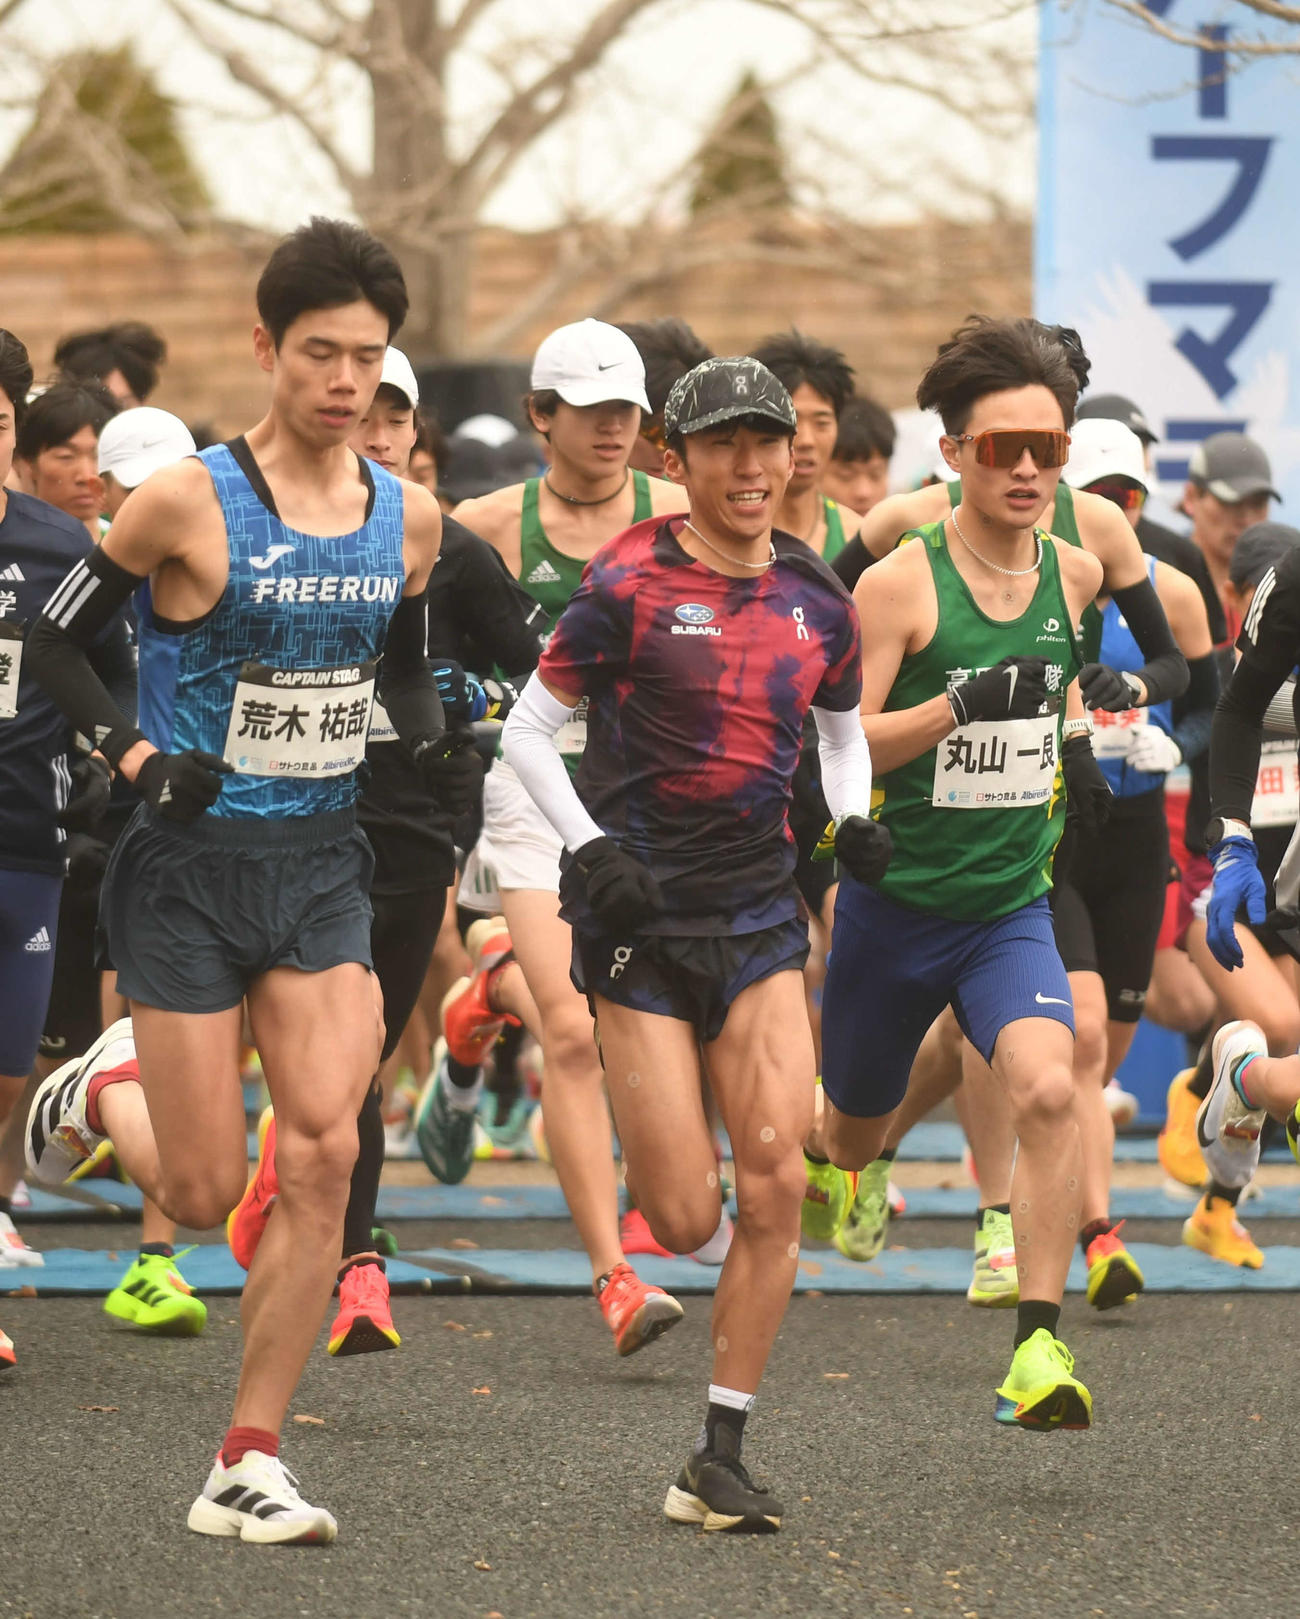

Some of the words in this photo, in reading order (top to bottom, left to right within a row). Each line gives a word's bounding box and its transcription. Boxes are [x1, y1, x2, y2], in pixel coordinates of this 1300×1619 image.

[1143, 0, 1278, 483] ーフマ
[250, 576, 399, 604] FREERUN
[527, 573, 561, 584] adidas
[671, 625, 722, 636] SUBARU
[1035, 634, 1067, 643] phiten
[271, 671, 332, 686] CAPTAIN
[331, 668, 361, 685] STAG
[237, 700, 311, 743] 荒木
[319, 697, 368, 743] 祐哉
[944, 735, 1008, 774] 丸山
[1016, 731, 1055, 771] 一良
